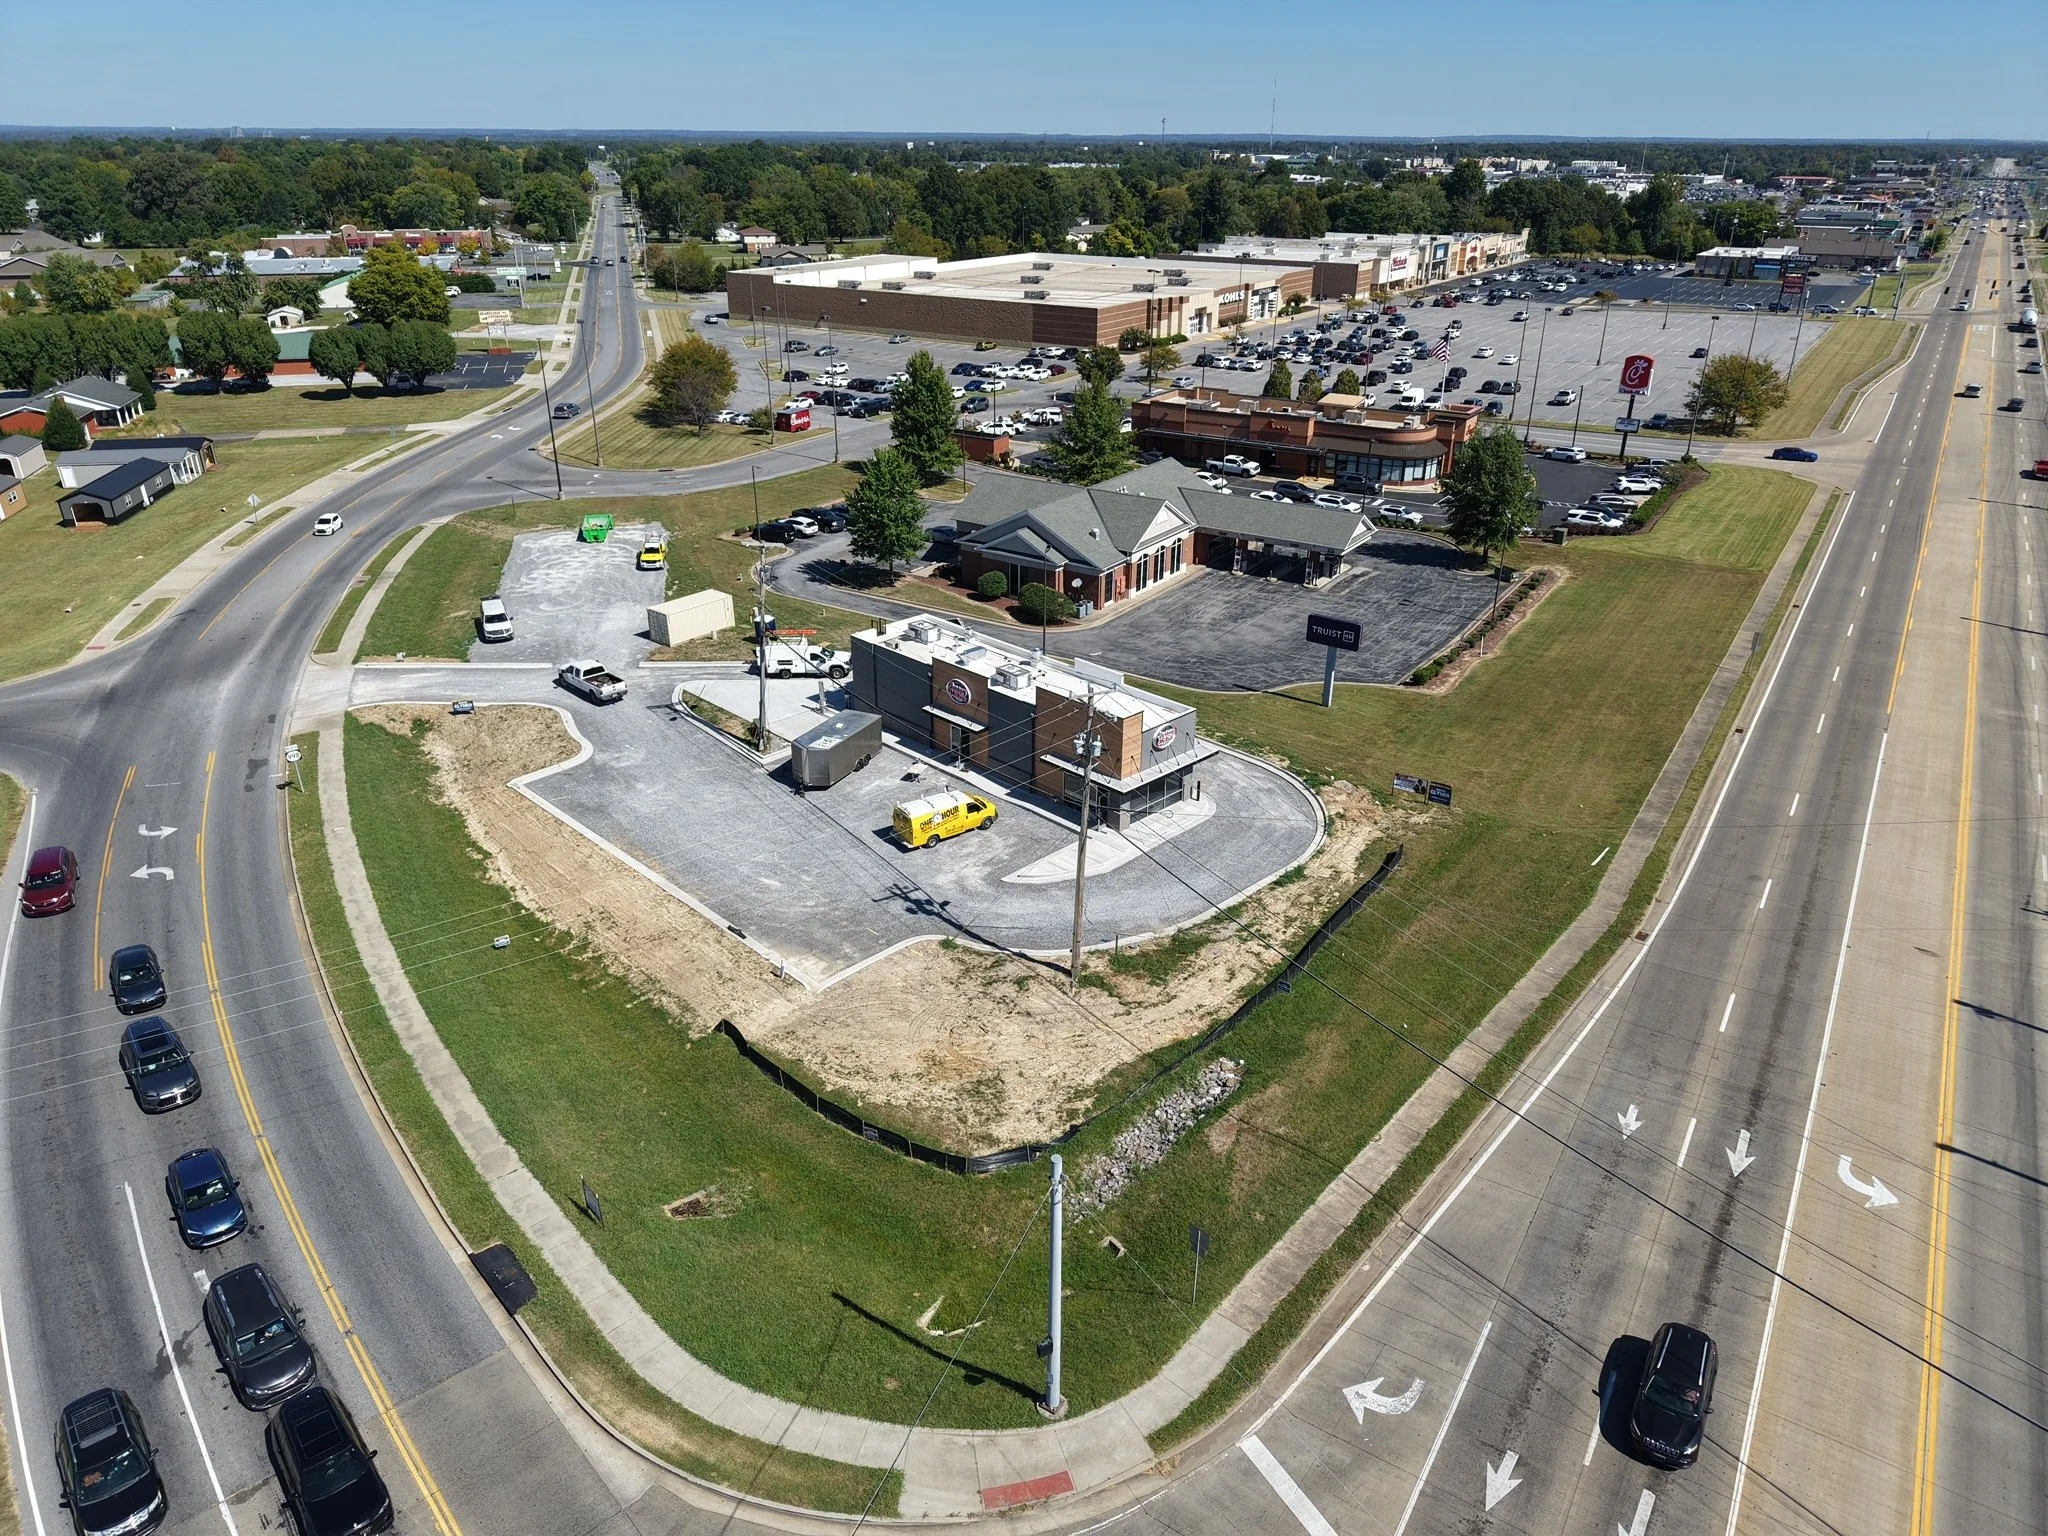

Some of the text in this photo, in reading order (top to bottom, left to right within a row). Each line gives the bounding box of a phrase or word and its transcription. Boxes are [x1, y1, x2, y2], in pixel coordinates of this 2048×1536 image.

[1312, 625, 1342, 638] TRUIST
[920, 818, 933, 830] ONE
[941, 806, 960, 820] HOUR
